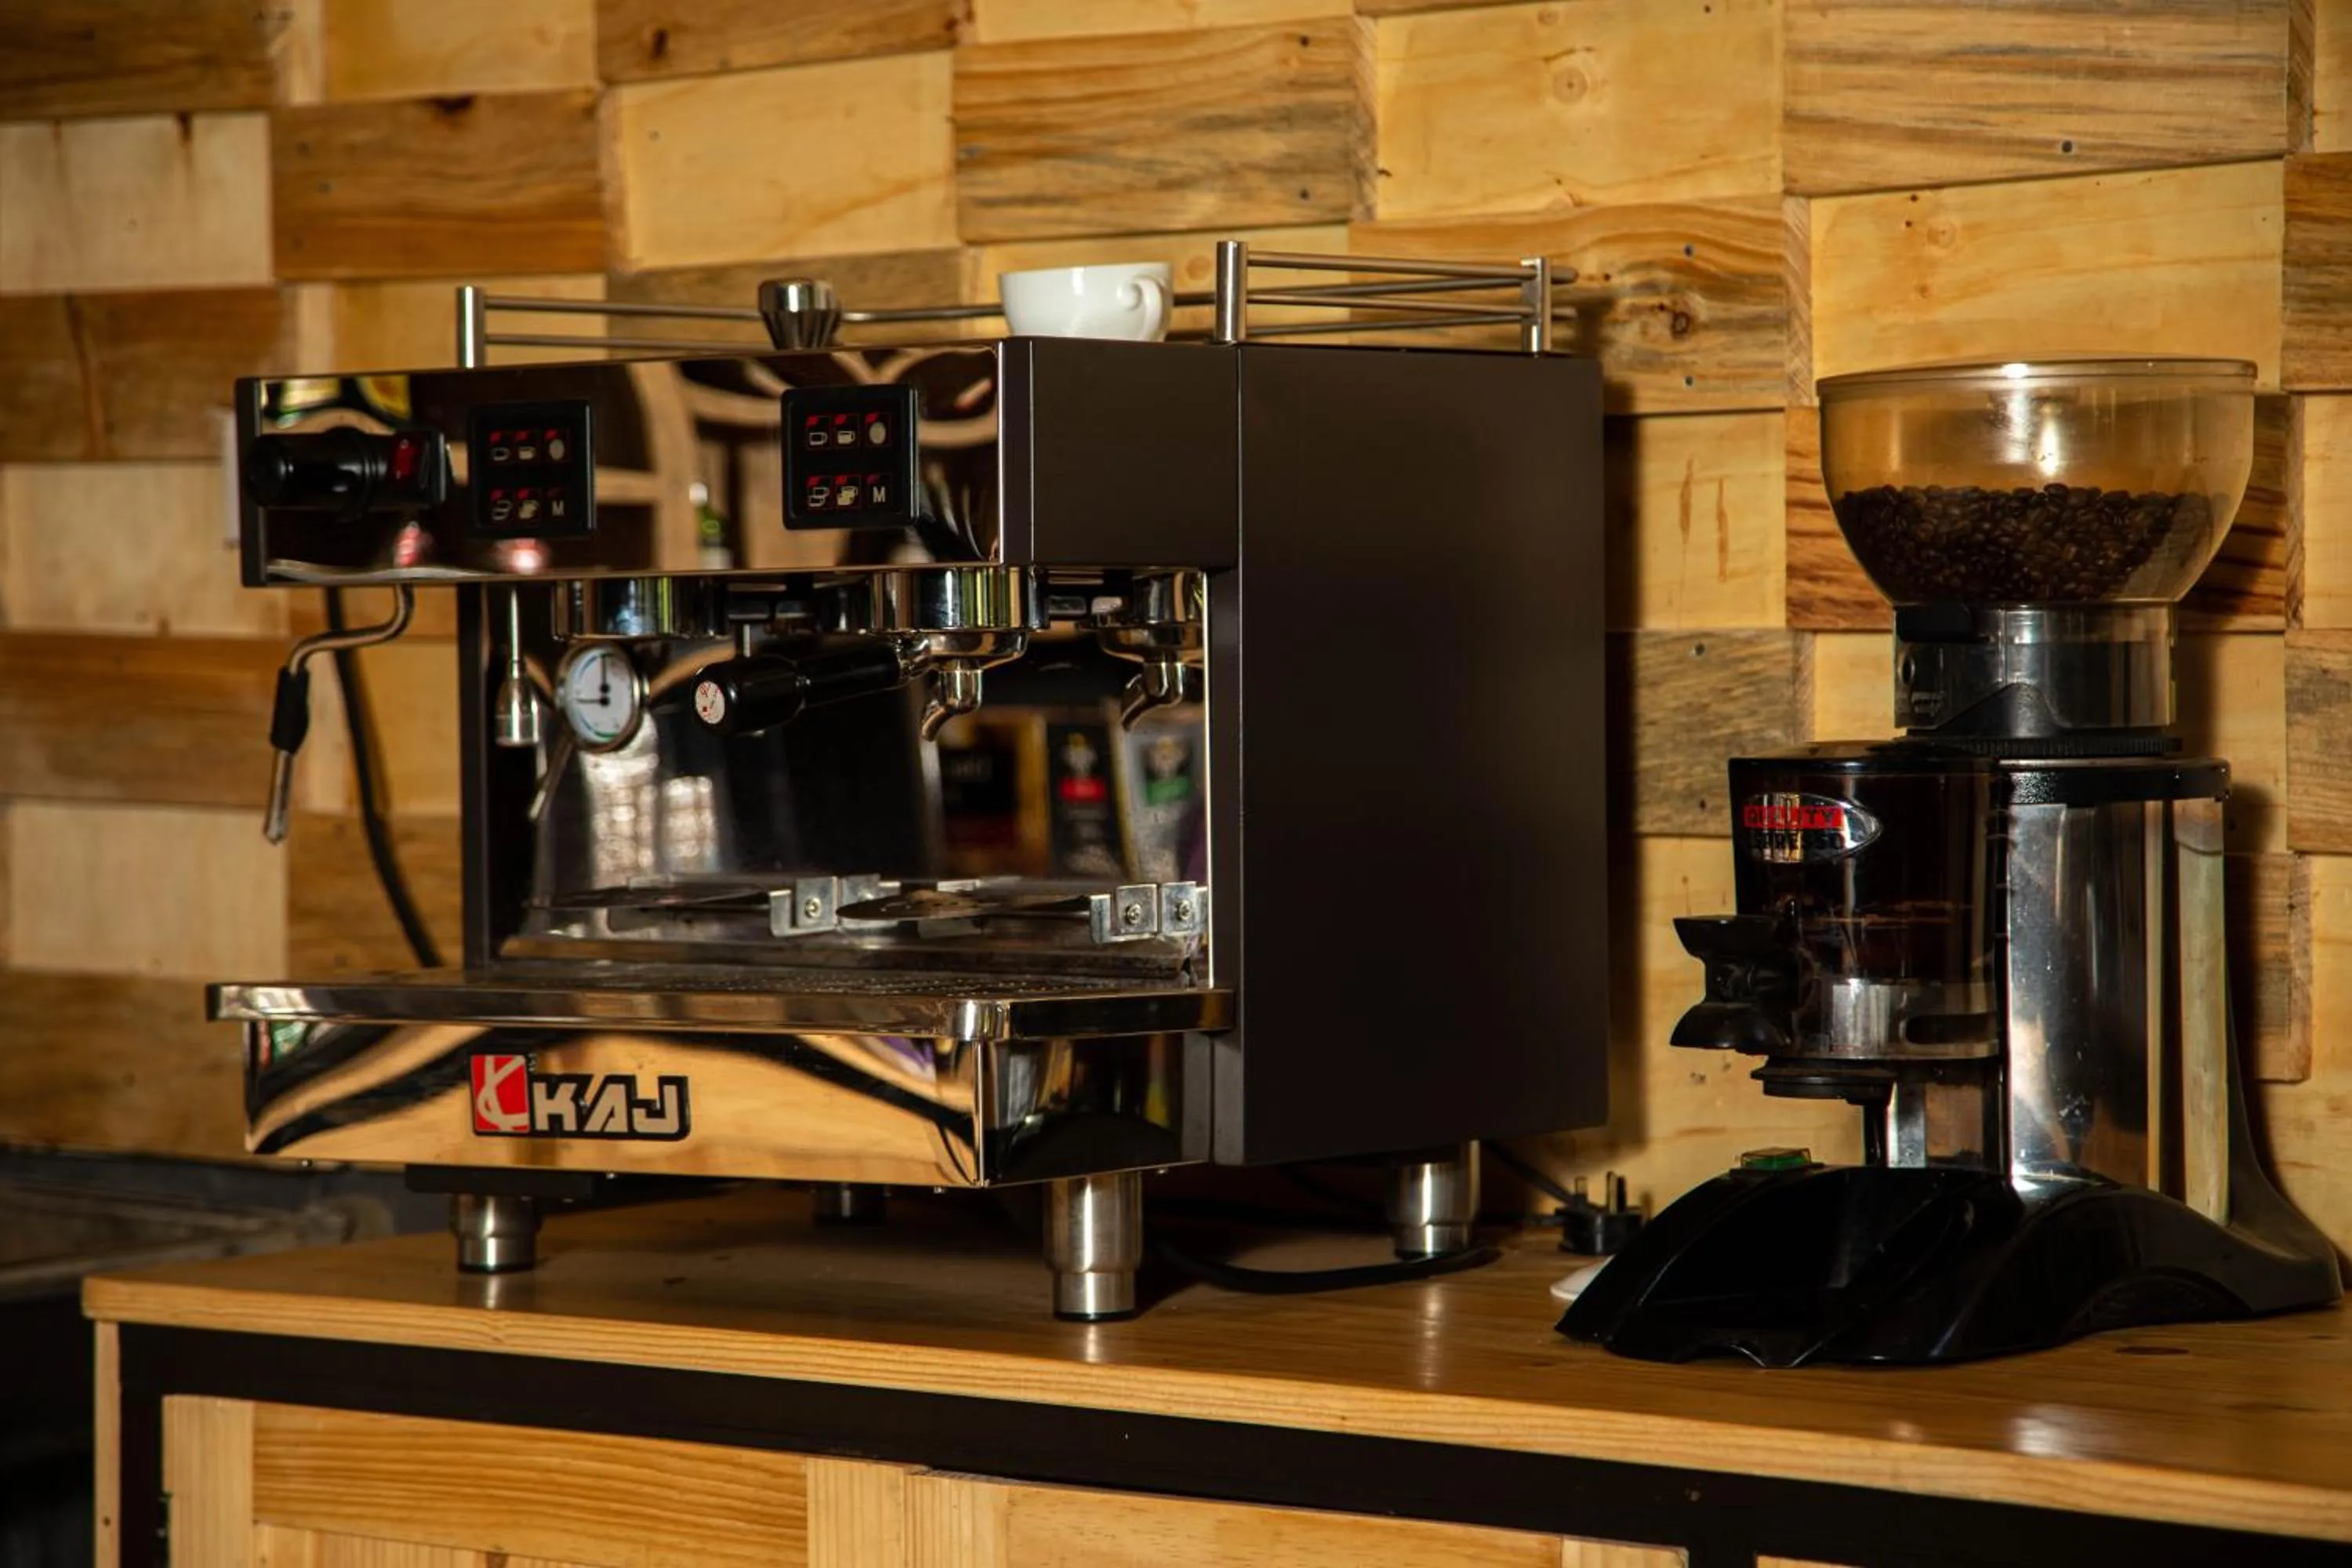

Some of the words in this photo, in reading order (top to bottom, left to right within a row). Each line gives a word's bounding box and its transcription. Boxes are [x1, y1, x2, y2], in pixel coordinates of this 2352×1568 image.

[873, 485, 886, 503] M
[551, 500, 564, 516] M
[1750, 831, 1843, 850] SPRESSO
[532, 1081, 681, 1134] KAJ
